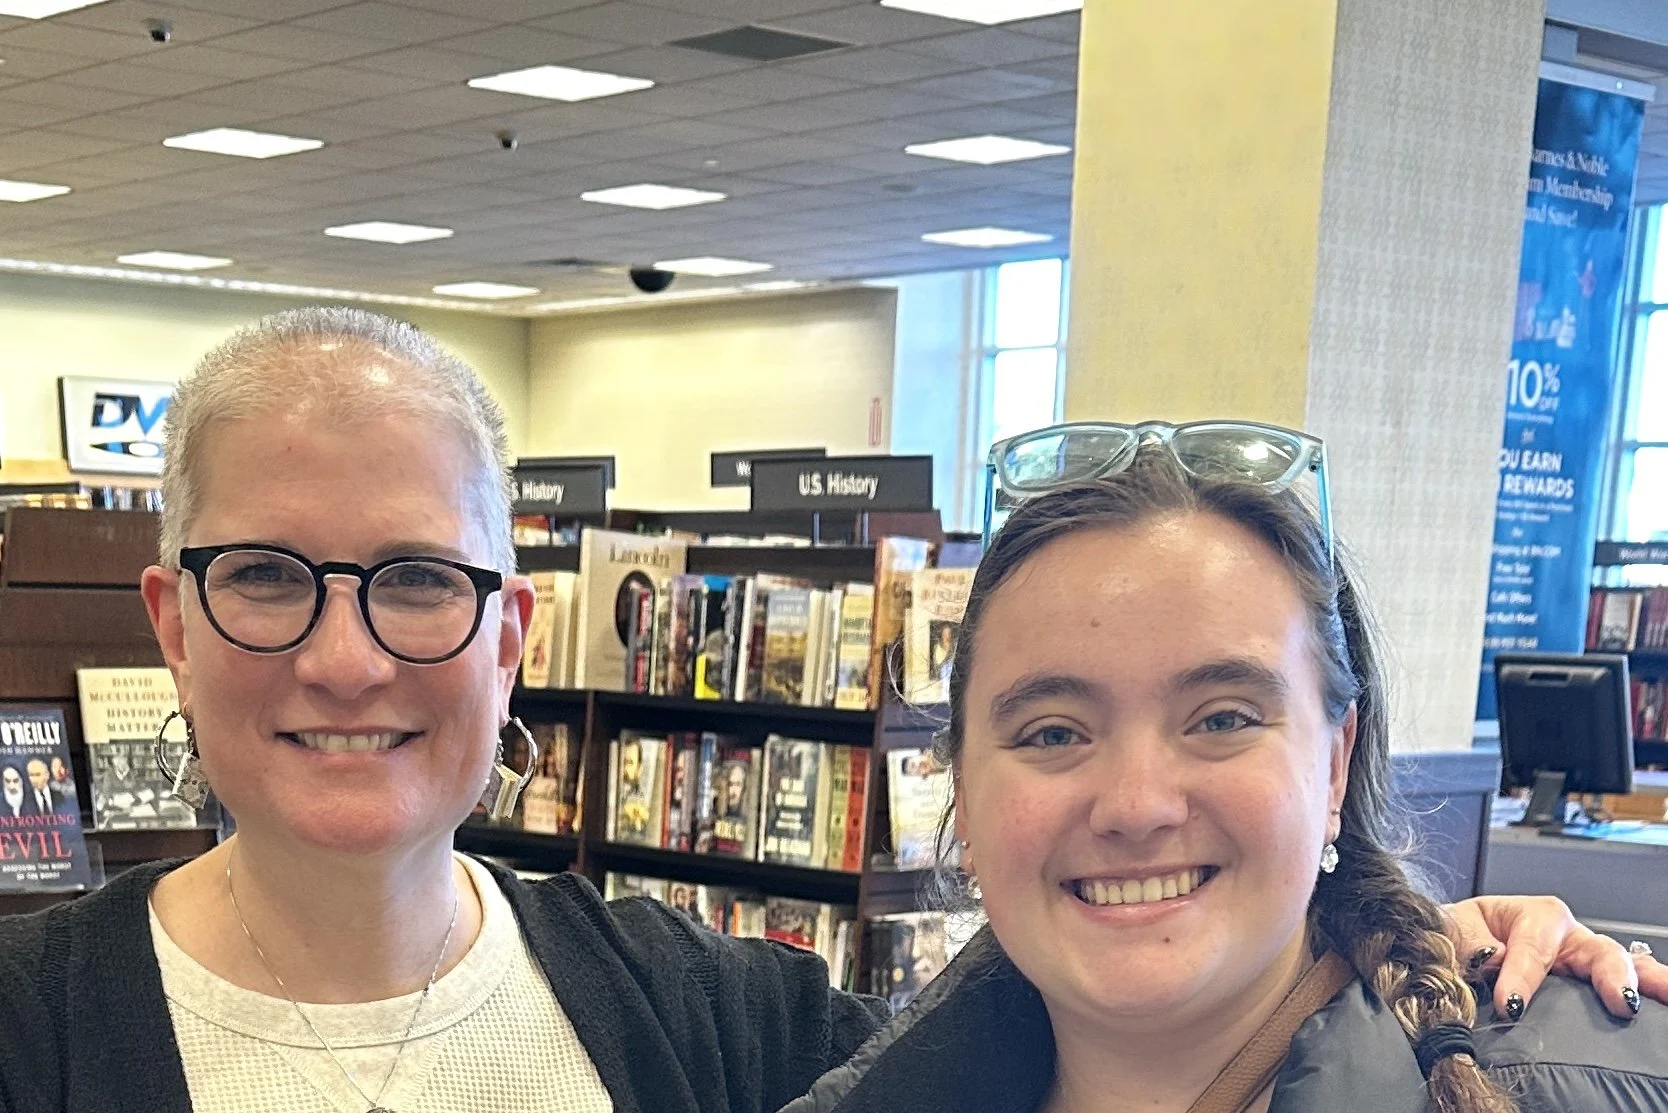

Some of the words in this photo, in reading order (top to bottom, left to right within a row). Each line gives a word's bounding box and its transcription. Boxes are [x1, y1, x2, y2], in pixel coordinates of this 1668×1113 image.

[1531, 148, 1564, 167] arnes
[1545, 176, 1613, 211] Membership
[91, 392, 173, 437] DV
[1499, 449, 1520, 470] OU
[1521, 450, 1563, 472] EARN
[521, 480, 565, 506] History
[827, 470, 879, 500] History
[1503, 473, 1575, 499] REWARDS
[107, 707, 162, 718] HISTORY
[1, 721, 61, 746] O'REILLY
[107, 722, 162, 732] MATTER
[0, 813, 76, 829] NFRONTING
[0, 831, 73, 860] EVIL
